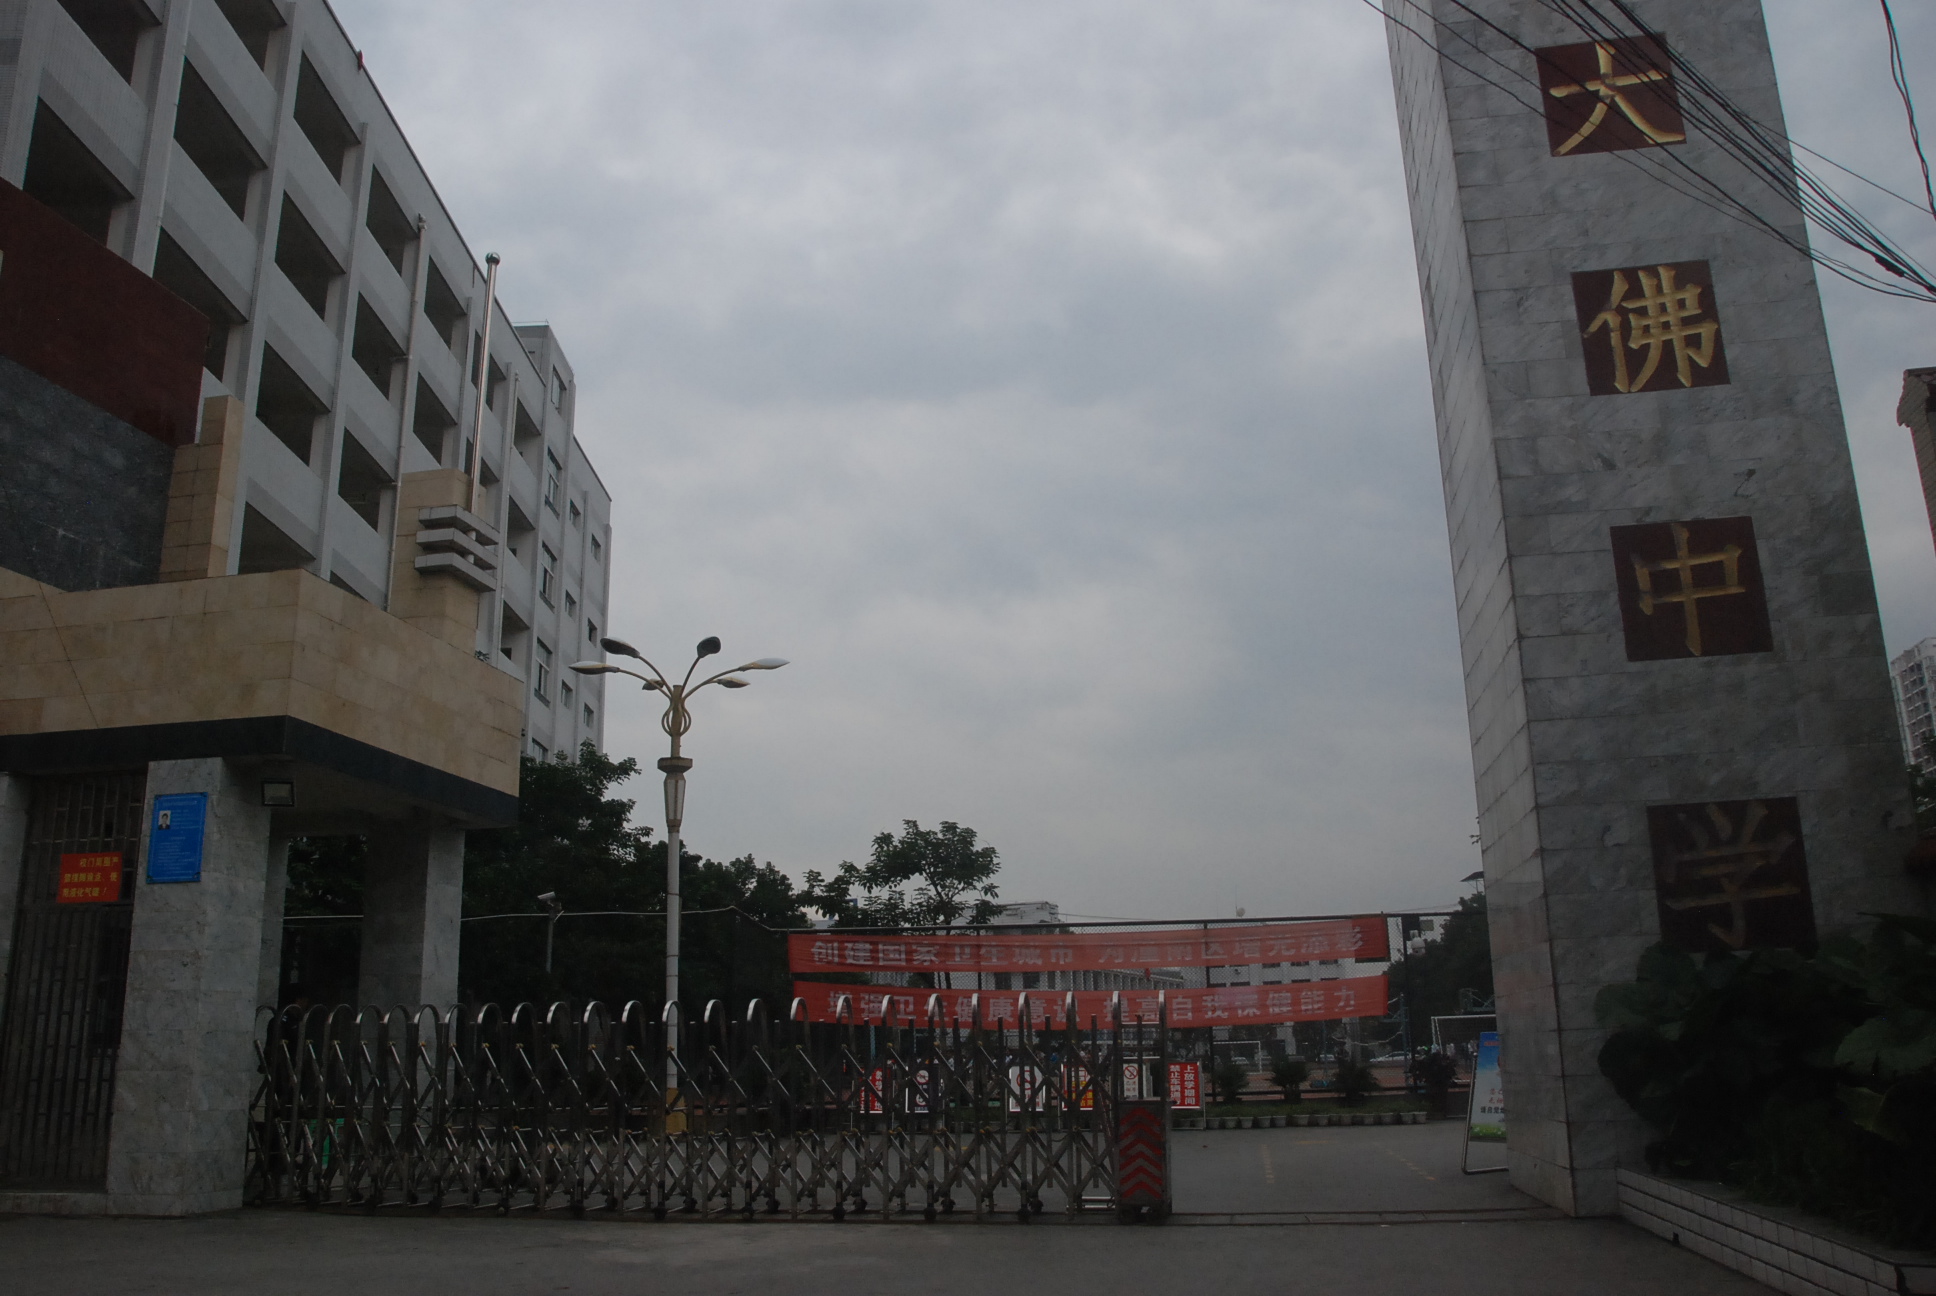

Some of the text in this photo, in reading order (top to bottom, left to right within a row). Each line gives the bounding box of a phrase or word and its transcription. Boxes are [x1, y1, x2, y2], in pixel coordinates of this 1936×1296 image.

[1549, 40, 1801, 949] 大佛中学
[811, 940, 1073, 965] 创建国家卫生城市
[1184, 1065, 1195, 1105] 上放学期间
